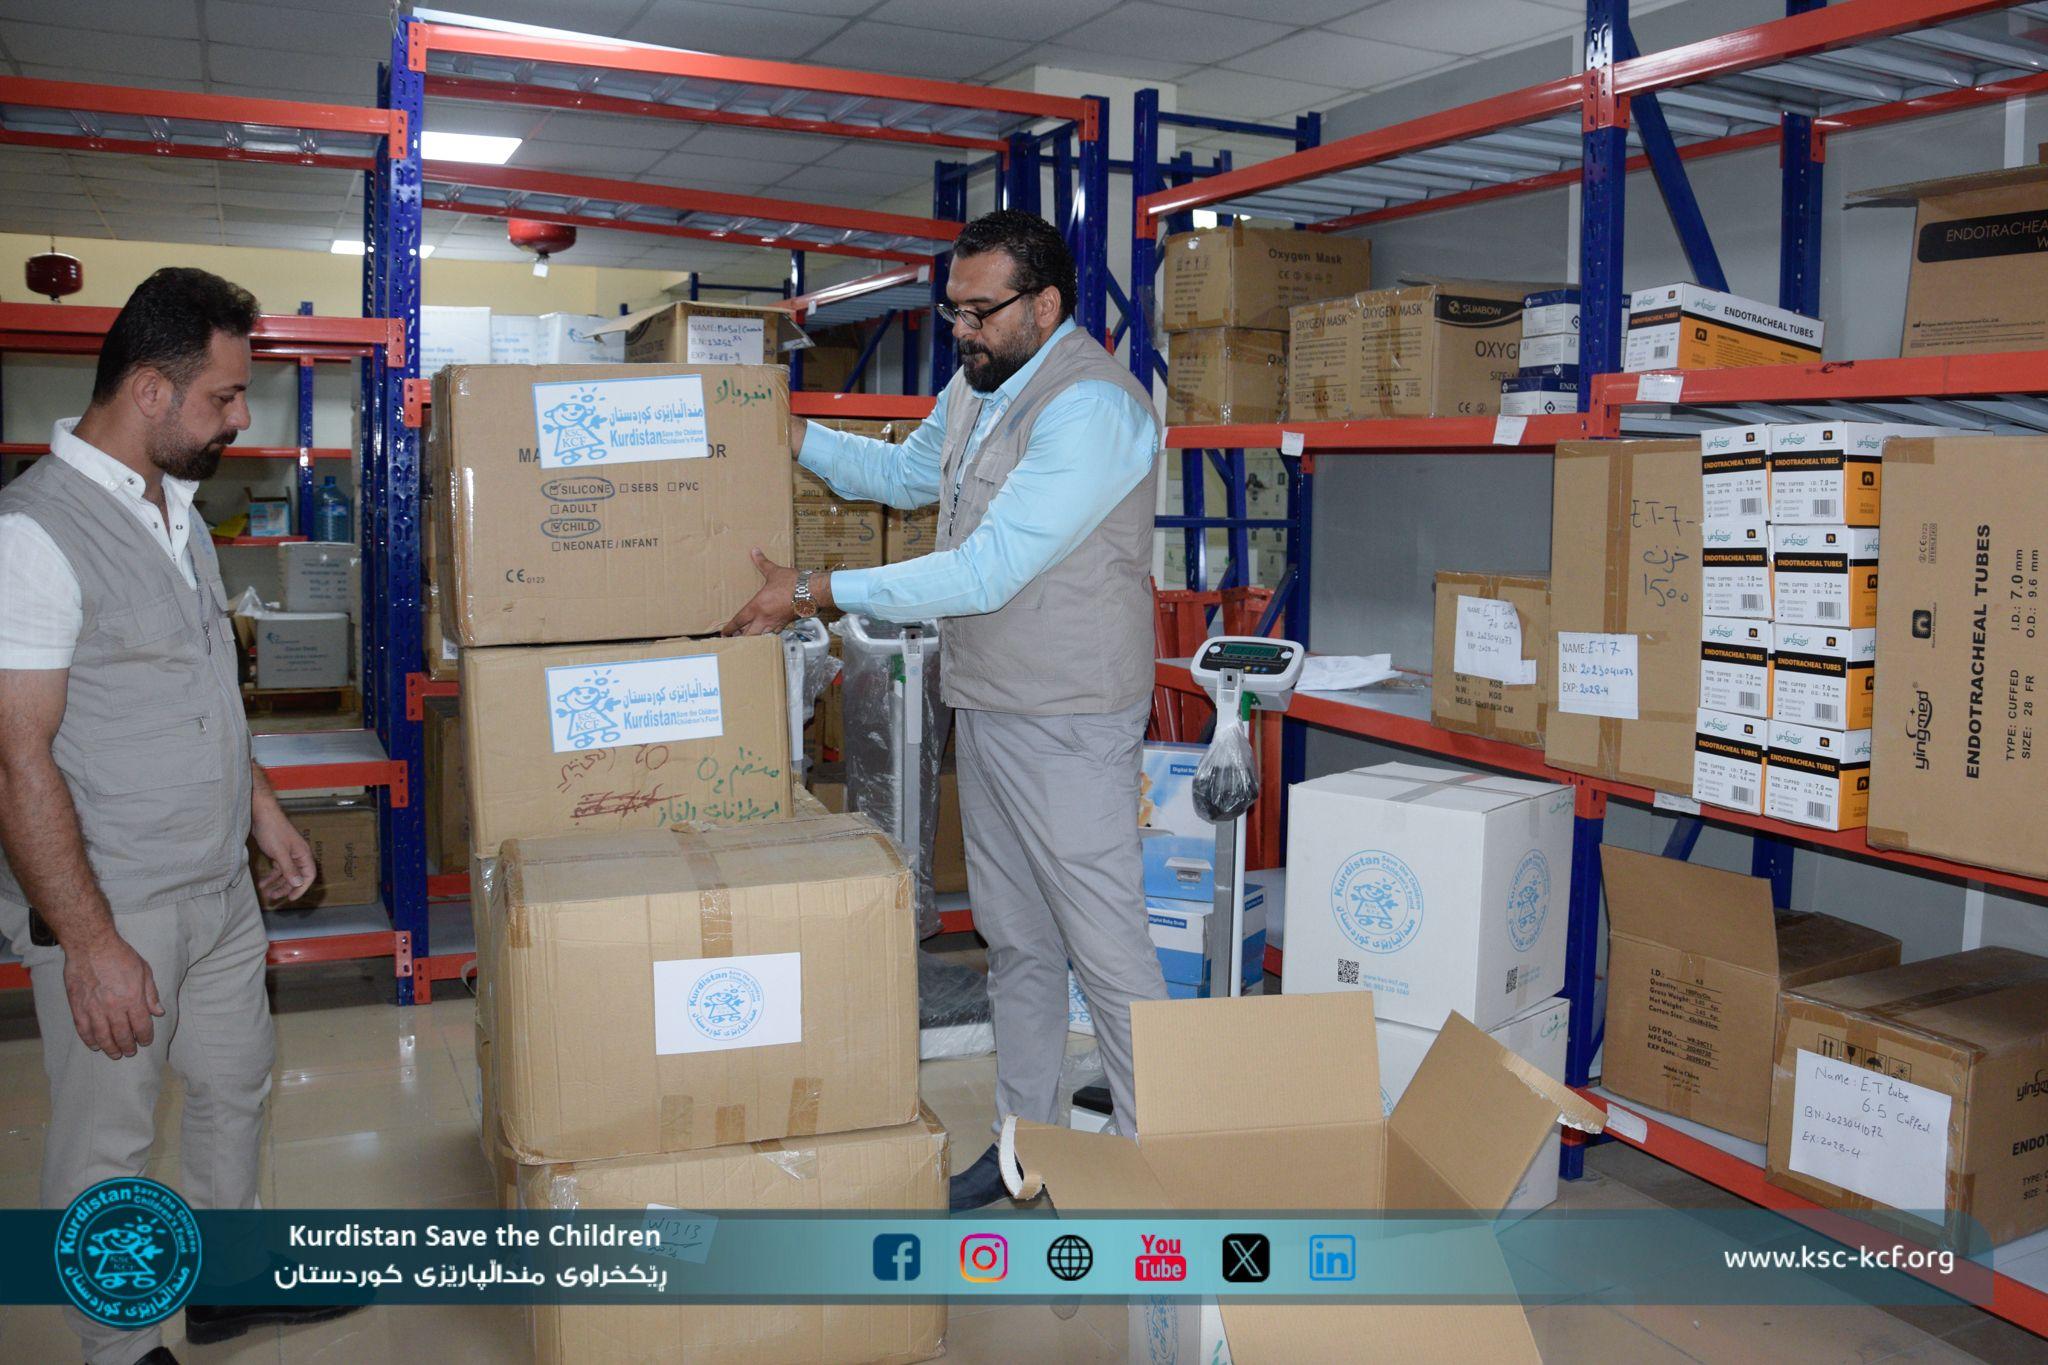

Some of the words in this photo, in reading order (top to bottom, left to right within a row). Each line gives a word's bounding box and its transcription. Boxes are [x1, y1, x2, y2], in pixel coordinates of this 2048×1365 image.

[1946, 218, 2048, 243] ENDOTRACHEA
[1268, 248, 1311, 263] Oxygen
[1315, 251, 1342, 265] Mask
[1362, 304, 1396, 319] OXYGEN
[1399, 302, 1423, 316] MASK
[1631, 313, 1664, 326] ENDOTRACHEAL
[1664, 311, 1679, 321] TUBES
[1296, 317, 1325, 331] OXYGEN
[1326, 314, 1348, 327] MASK
[1724, 305, 1788, 331] ENDOTRACHEAL
[1788, 323, 1815, 339] TUBES
[562, 436, 586, 448] KCF
[610, 428, 662, 448] Kurdistan
[1704, 458, 1744, 469] ENDOTRACHEAL
[1744, 456, 1762, 466] TUBES
[1775, 457, 1820, 467] ENDOTRACHEAL
[1820, 456, 1839, 466] TUBES
[561, 484, 611, 495] SILICONE
[631, 483, 659, 493] SEBS
[678, 482, 700, 492] PVC
[561, 503, 598, 514] ADULT
[562, 521, 595, 532] CHILD
[563, 540, 613, 550] NEONATE
[621, 538, 659, 548] INFANT
[1704, 554, 1745, 562] ENDOTRACHEAL
[1745, 554, 1763, 562] TUBES
[1778, 559, 1823, 568] ENDOTRACHEAL
[1823, 560, 1843, 568] TUBES
[1974, 524, 1991, 597] TUBES
[2015, 549, 2023, 571] mm
[2031, 549, 2039, 572] mm
[2010, 574, 2024, 600] 7.0
[2028, 578, 2038, 598] 9.6
[2011, 606, 2022, 631] I.D.:
[2026, 607, 2037, 638] O.D.:
[1562, 643, 1588, 654] NAME:
[1609, 641, 1621, 657] 7
[1705, 648, 1745, 660] ENDOTRACHEAL
[1745, 652, 1764, 662] TUBES
[1562, 662, 1578, 674] B.N:
[1778, 657, 1822, 670] ENDOTRACHEAL
[1822, 663, 1842, 672] TUBES
[1562, 683, 1578, 693] EXP:
[1966, 603, 1988, 779] ENDOTRACHEAL
[2025, 675, 2035, 692] FR
[1488, 691, 1502, 701] KGS
[2007, 669, 2019, 719] CUFFED
[1503, 705, 1514, 714] CM
[2024, 701, 2033, 716] 28
[623, 709, 678, 730] Kurdistan
[1912, 690, 1933, 771] yingmed
[1698, 739, 1740, 755] ENDOTRACHEAL
[1739, 748, 1758, 758] TUBES
[2006, 724, 2017, 761] TYPE:
[2021, 727, 2032, 759] SIZE:
[1770, 753, 1816, 768] ENDOTRACHEAL
[1815, 762, 1835, 772] TUBES
[1333, 855, 1381, 898] Kurdistan
[689, 971, 728, 1007] Kurdistan
[1649, 987, 1667, 997] Gross
[1649, 996, 1660, 1004] Net
[1648, 1004, 1669, 1016] Carton
[1648, 1024, 1661, 1034] LOT
[1647, 1042, 1660, 1051] EXP
[1648, 1033, 1662, 1043] MFG
[1887, 1083, 1910, 1103] tube
[1861, 1097, 1888, 1119] 6.5
[1896, 1112, 1931, 1133] Cuffed
[2022, 1173, 2043, 1186] TYPE:
